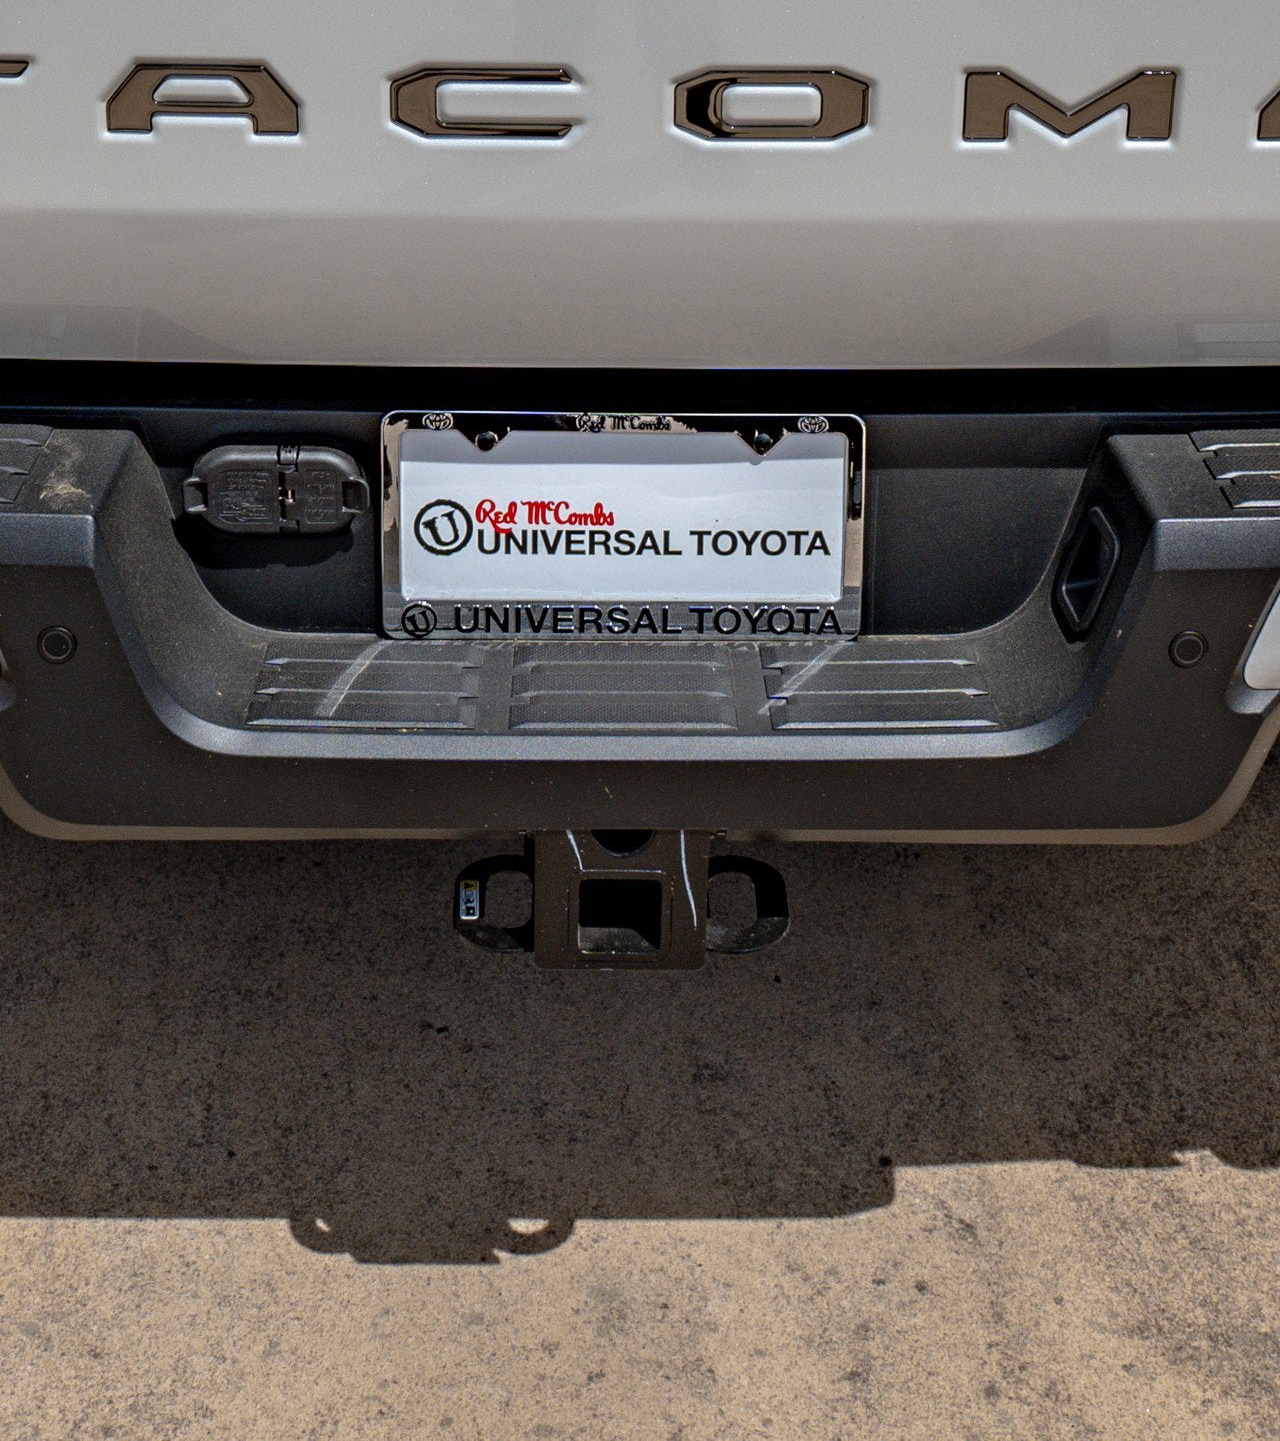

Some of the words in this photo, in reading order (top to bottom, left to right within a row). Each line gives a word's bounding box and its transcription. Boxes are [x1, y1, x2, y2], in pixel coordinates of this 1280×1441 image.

[577, 412, 605, 433] Red
[475, 499, 517, 534] Red
[521, 500, 615, 527] McCombs
[477, 528, 682, 556] UNIVERSAL
[689, 529, 831, 556] TOYOTA
[454, 604, 682, 634] UNIVERSAL
[689, 605, 843, 635] TOYOTA
